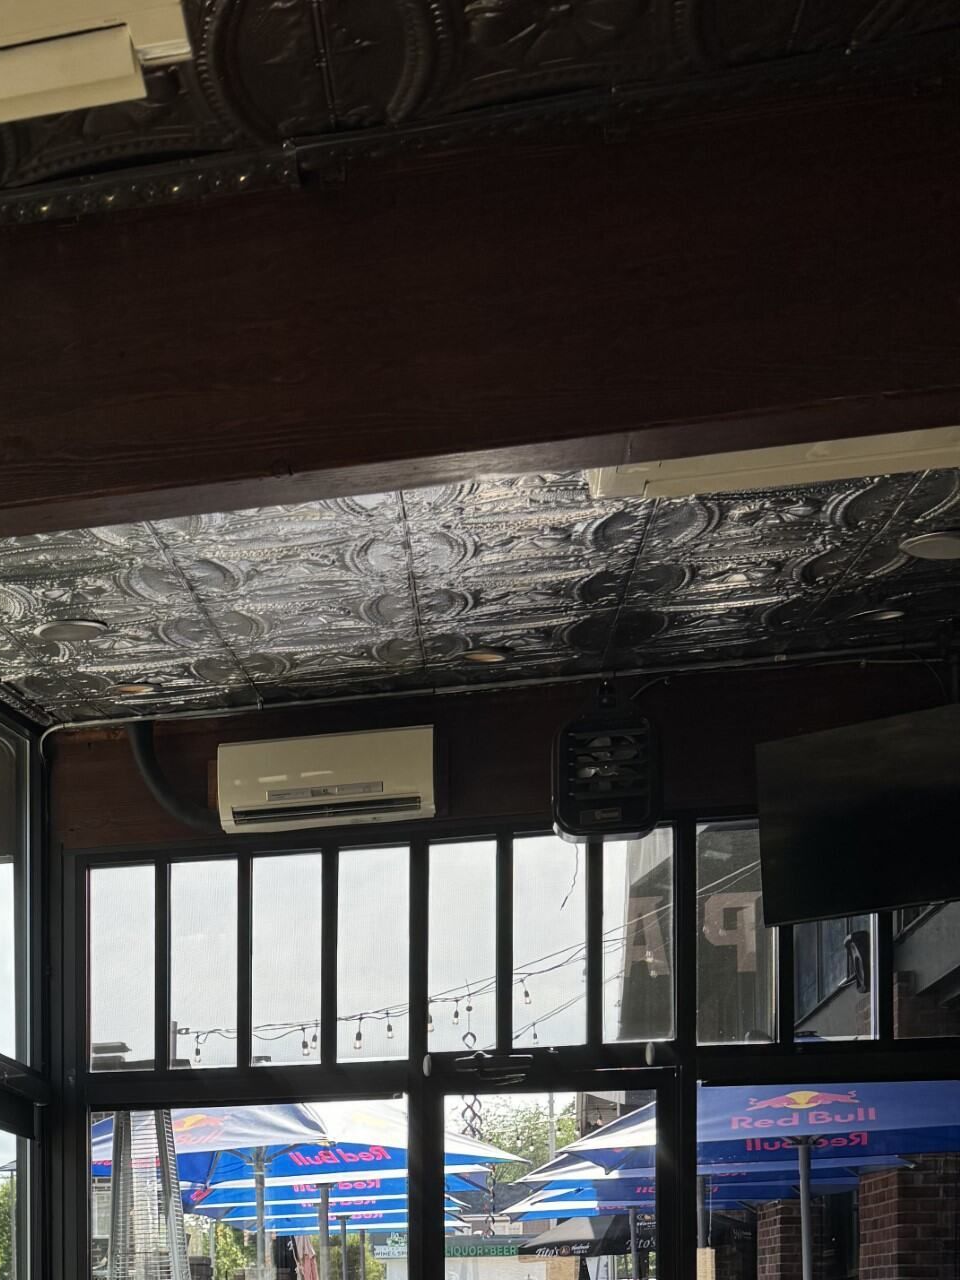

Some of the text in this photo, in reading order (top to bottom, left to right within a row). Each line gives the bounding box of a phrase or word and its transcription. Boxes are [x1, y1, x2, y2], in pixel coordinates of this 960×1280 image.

[731, 1107, 876, 1129] Red Bull
[445, 1245, 516, 1256] LIQUOR BEER
